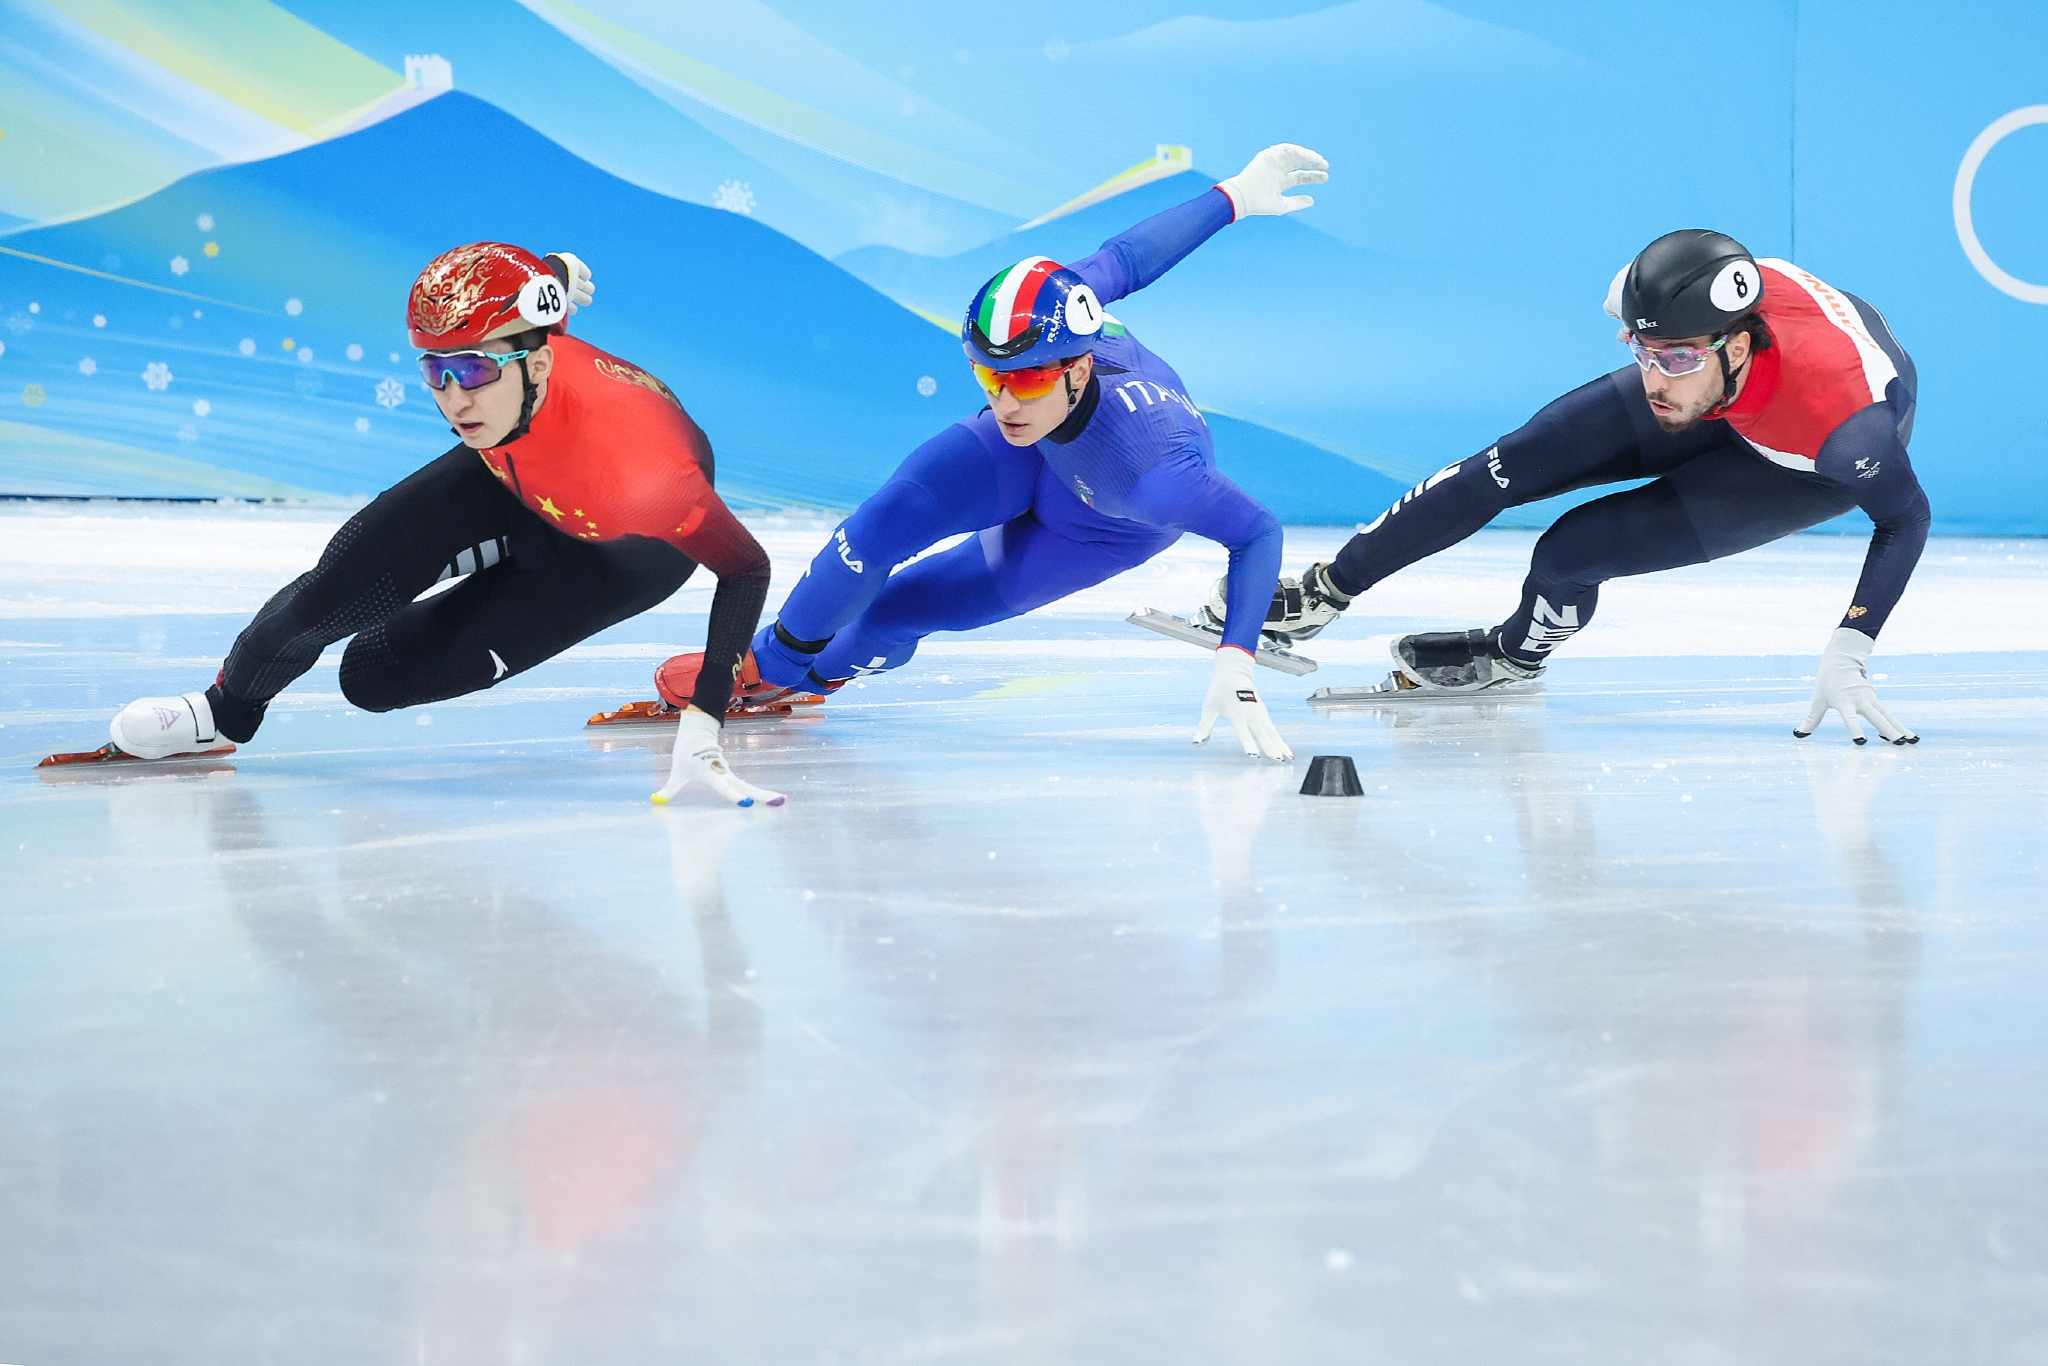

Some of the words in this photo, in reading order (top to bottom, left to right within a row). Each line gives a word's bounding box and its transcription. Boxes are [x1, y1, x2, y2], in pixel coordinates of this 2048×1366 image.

[537, 284, 561, 315] 48
[1733, 271, 1748, 299] 8
[1077, 294, 1094, 321] 7
[1486, 446, 1511, 489] FILA
[834, 527, 864, 574] FILA
